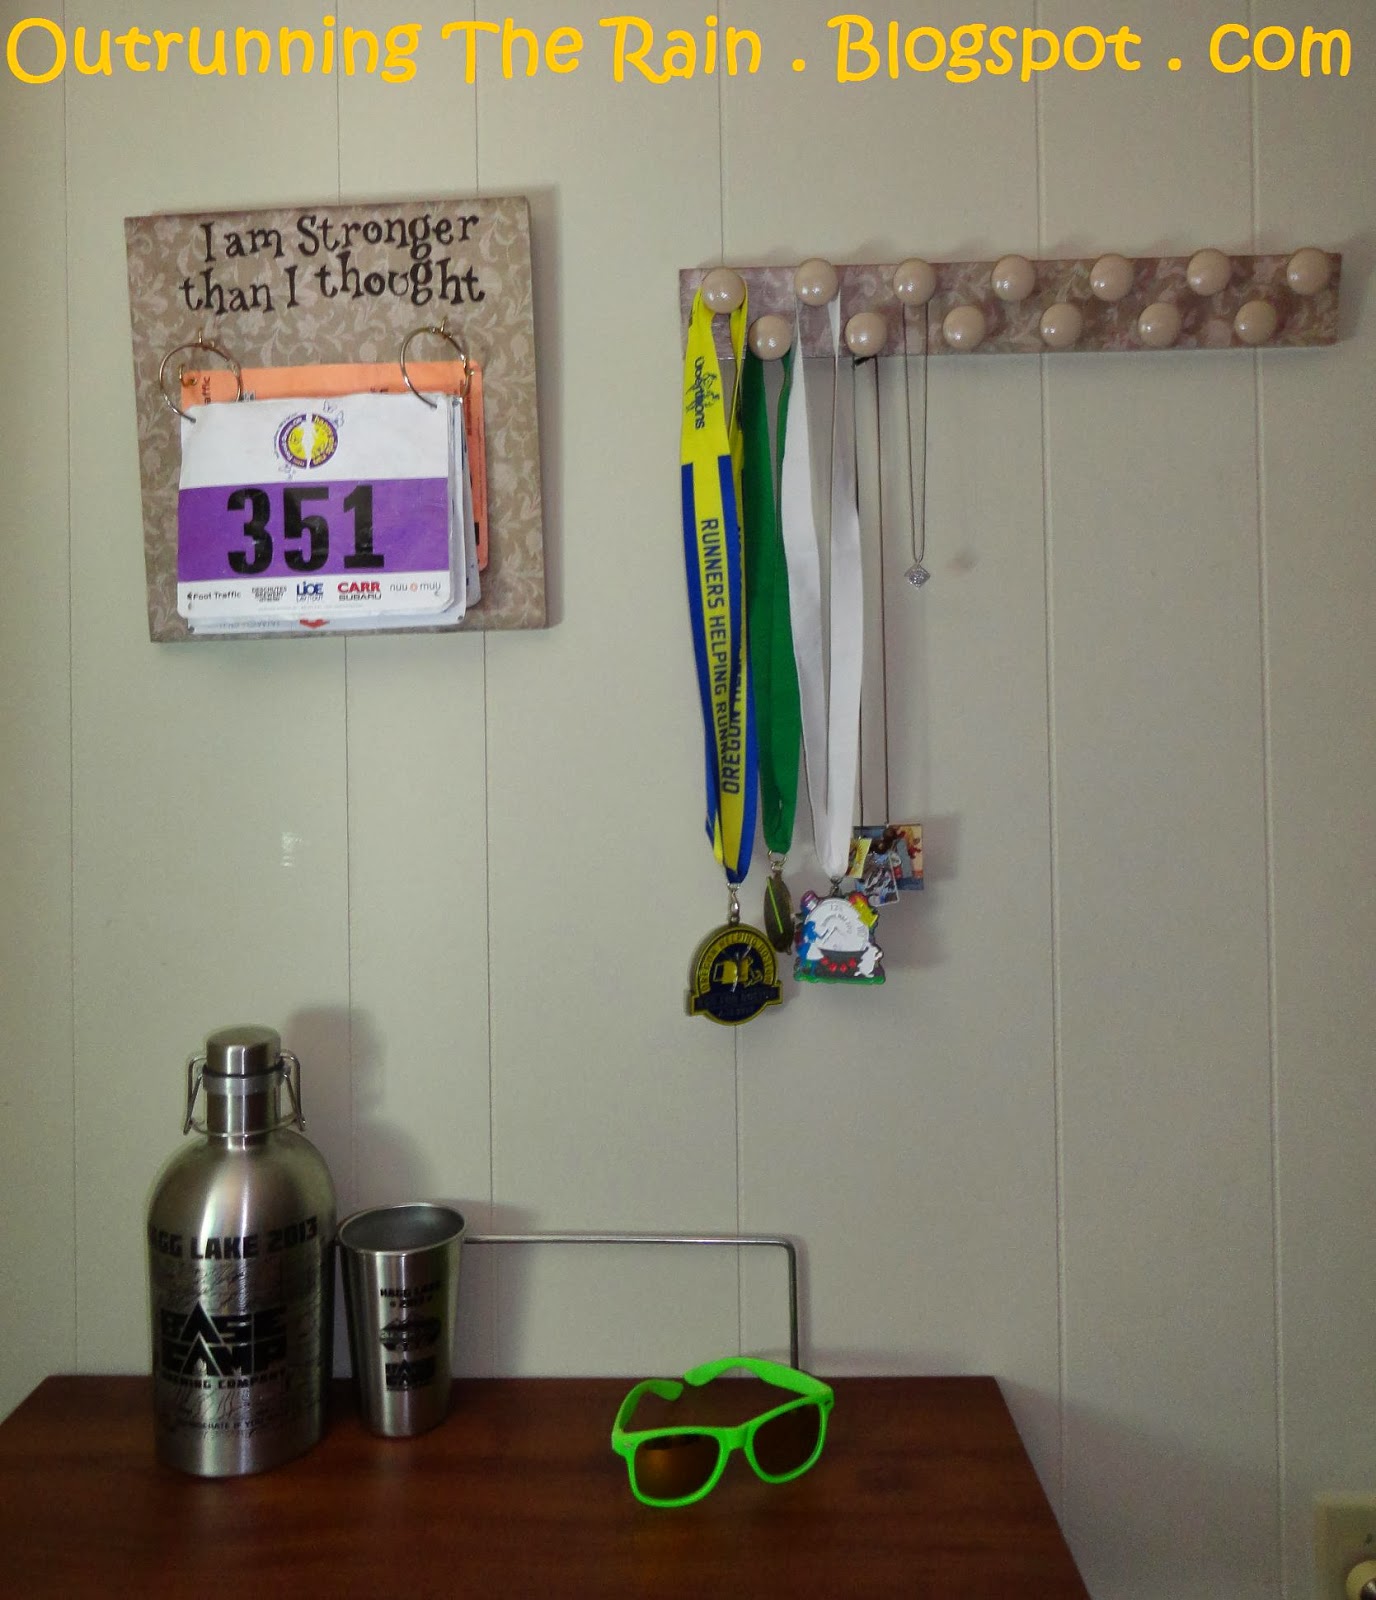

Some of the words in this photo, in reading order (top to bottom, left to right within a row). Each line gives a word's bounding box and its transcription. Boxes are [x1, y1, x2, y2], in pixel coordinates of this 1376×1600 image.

[201, 221, 216, 262] I
[224, 227, 285, 258] am
[297, 214, 480, 261] Stronger
[179, 267, 277, 315] than
[284, 266, 301, 308] I
[315, 250, 486, 306] thought
[227, 484, 385, 576] 351
[337, 581, 381, 593] CARR
[700, 518, 725, 610] RUNNERS
[193, 592, 212, 600] Foot
[215, 591, 241, 600] Traffic
[338, 592, 381, 600] SUBARU
[709, 615, 727, 696] HELPING
[716, 703, 730, 765] RUNN
[190, 1235, 259, 1260] LAKE
[267, 1217, 319, 1252] 2013
